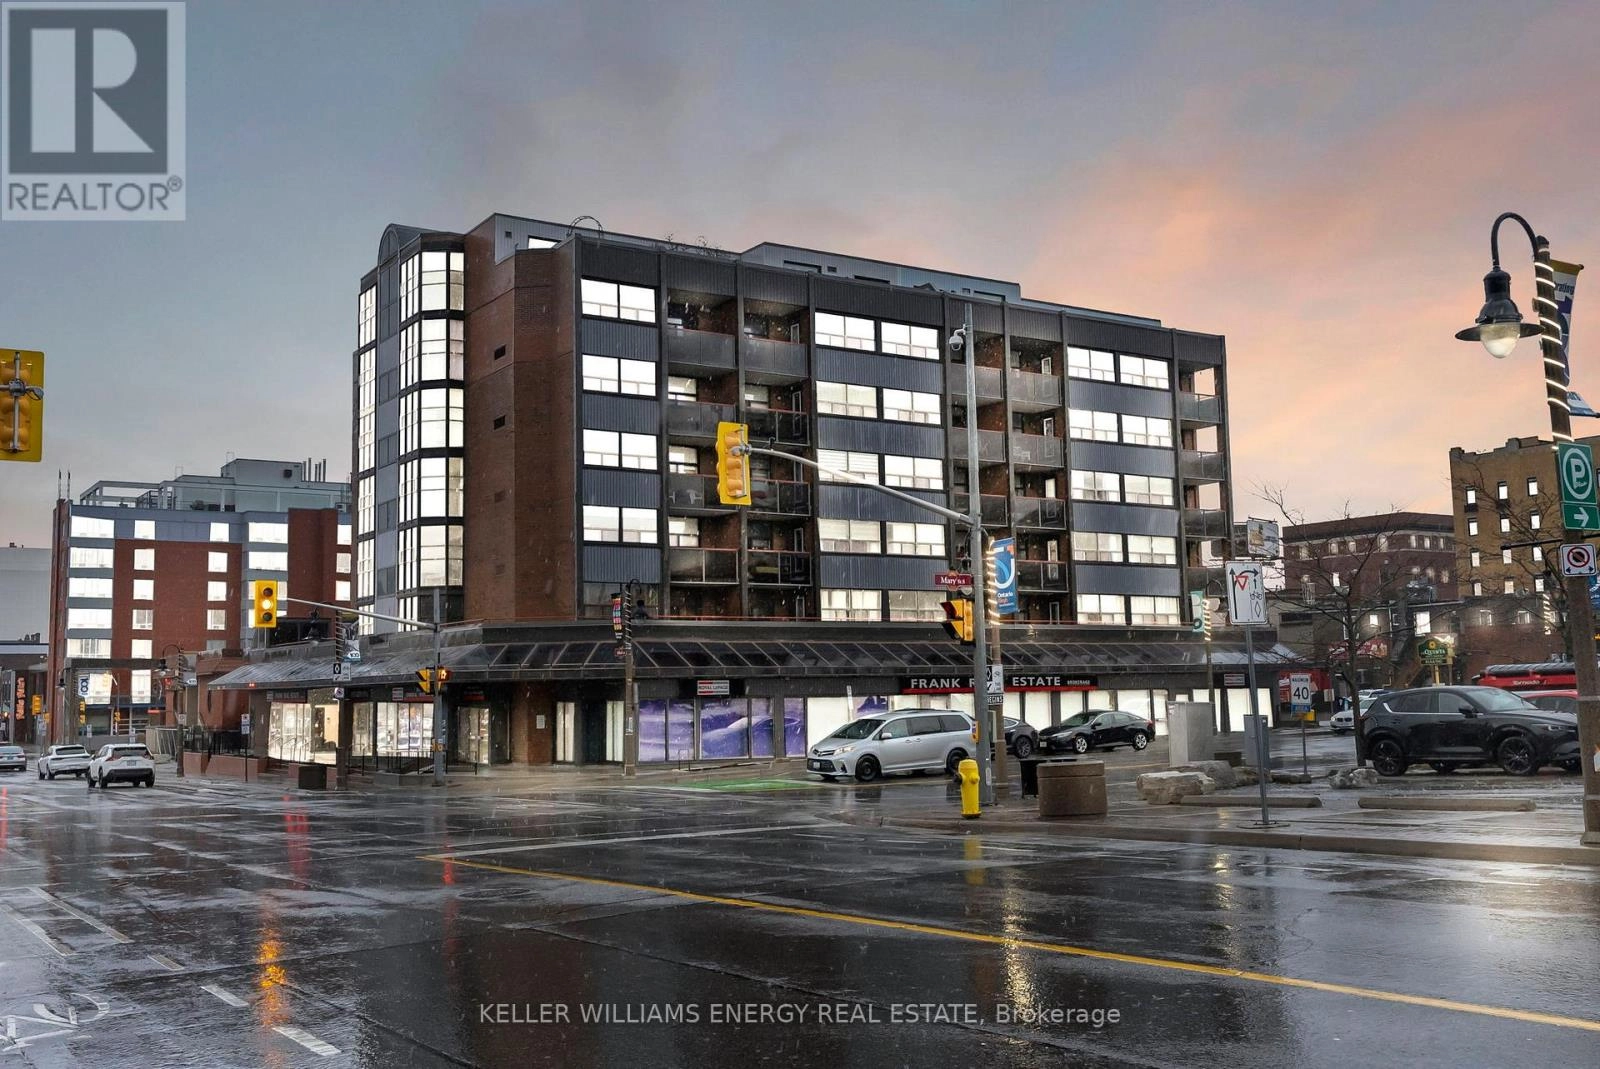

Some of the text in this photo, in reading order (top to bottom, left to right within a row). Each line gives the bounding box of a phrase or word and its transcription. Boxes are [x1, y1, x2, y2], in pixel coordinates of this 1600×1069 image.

[940, 576, 956, 585] Mary
[997, 590, 1014, 598] Ontario
[910, 678, 961, 689] FRANK
[1012, 676, 1061, 687] ESTATE
[1293, 686, 1309, 700] 40
